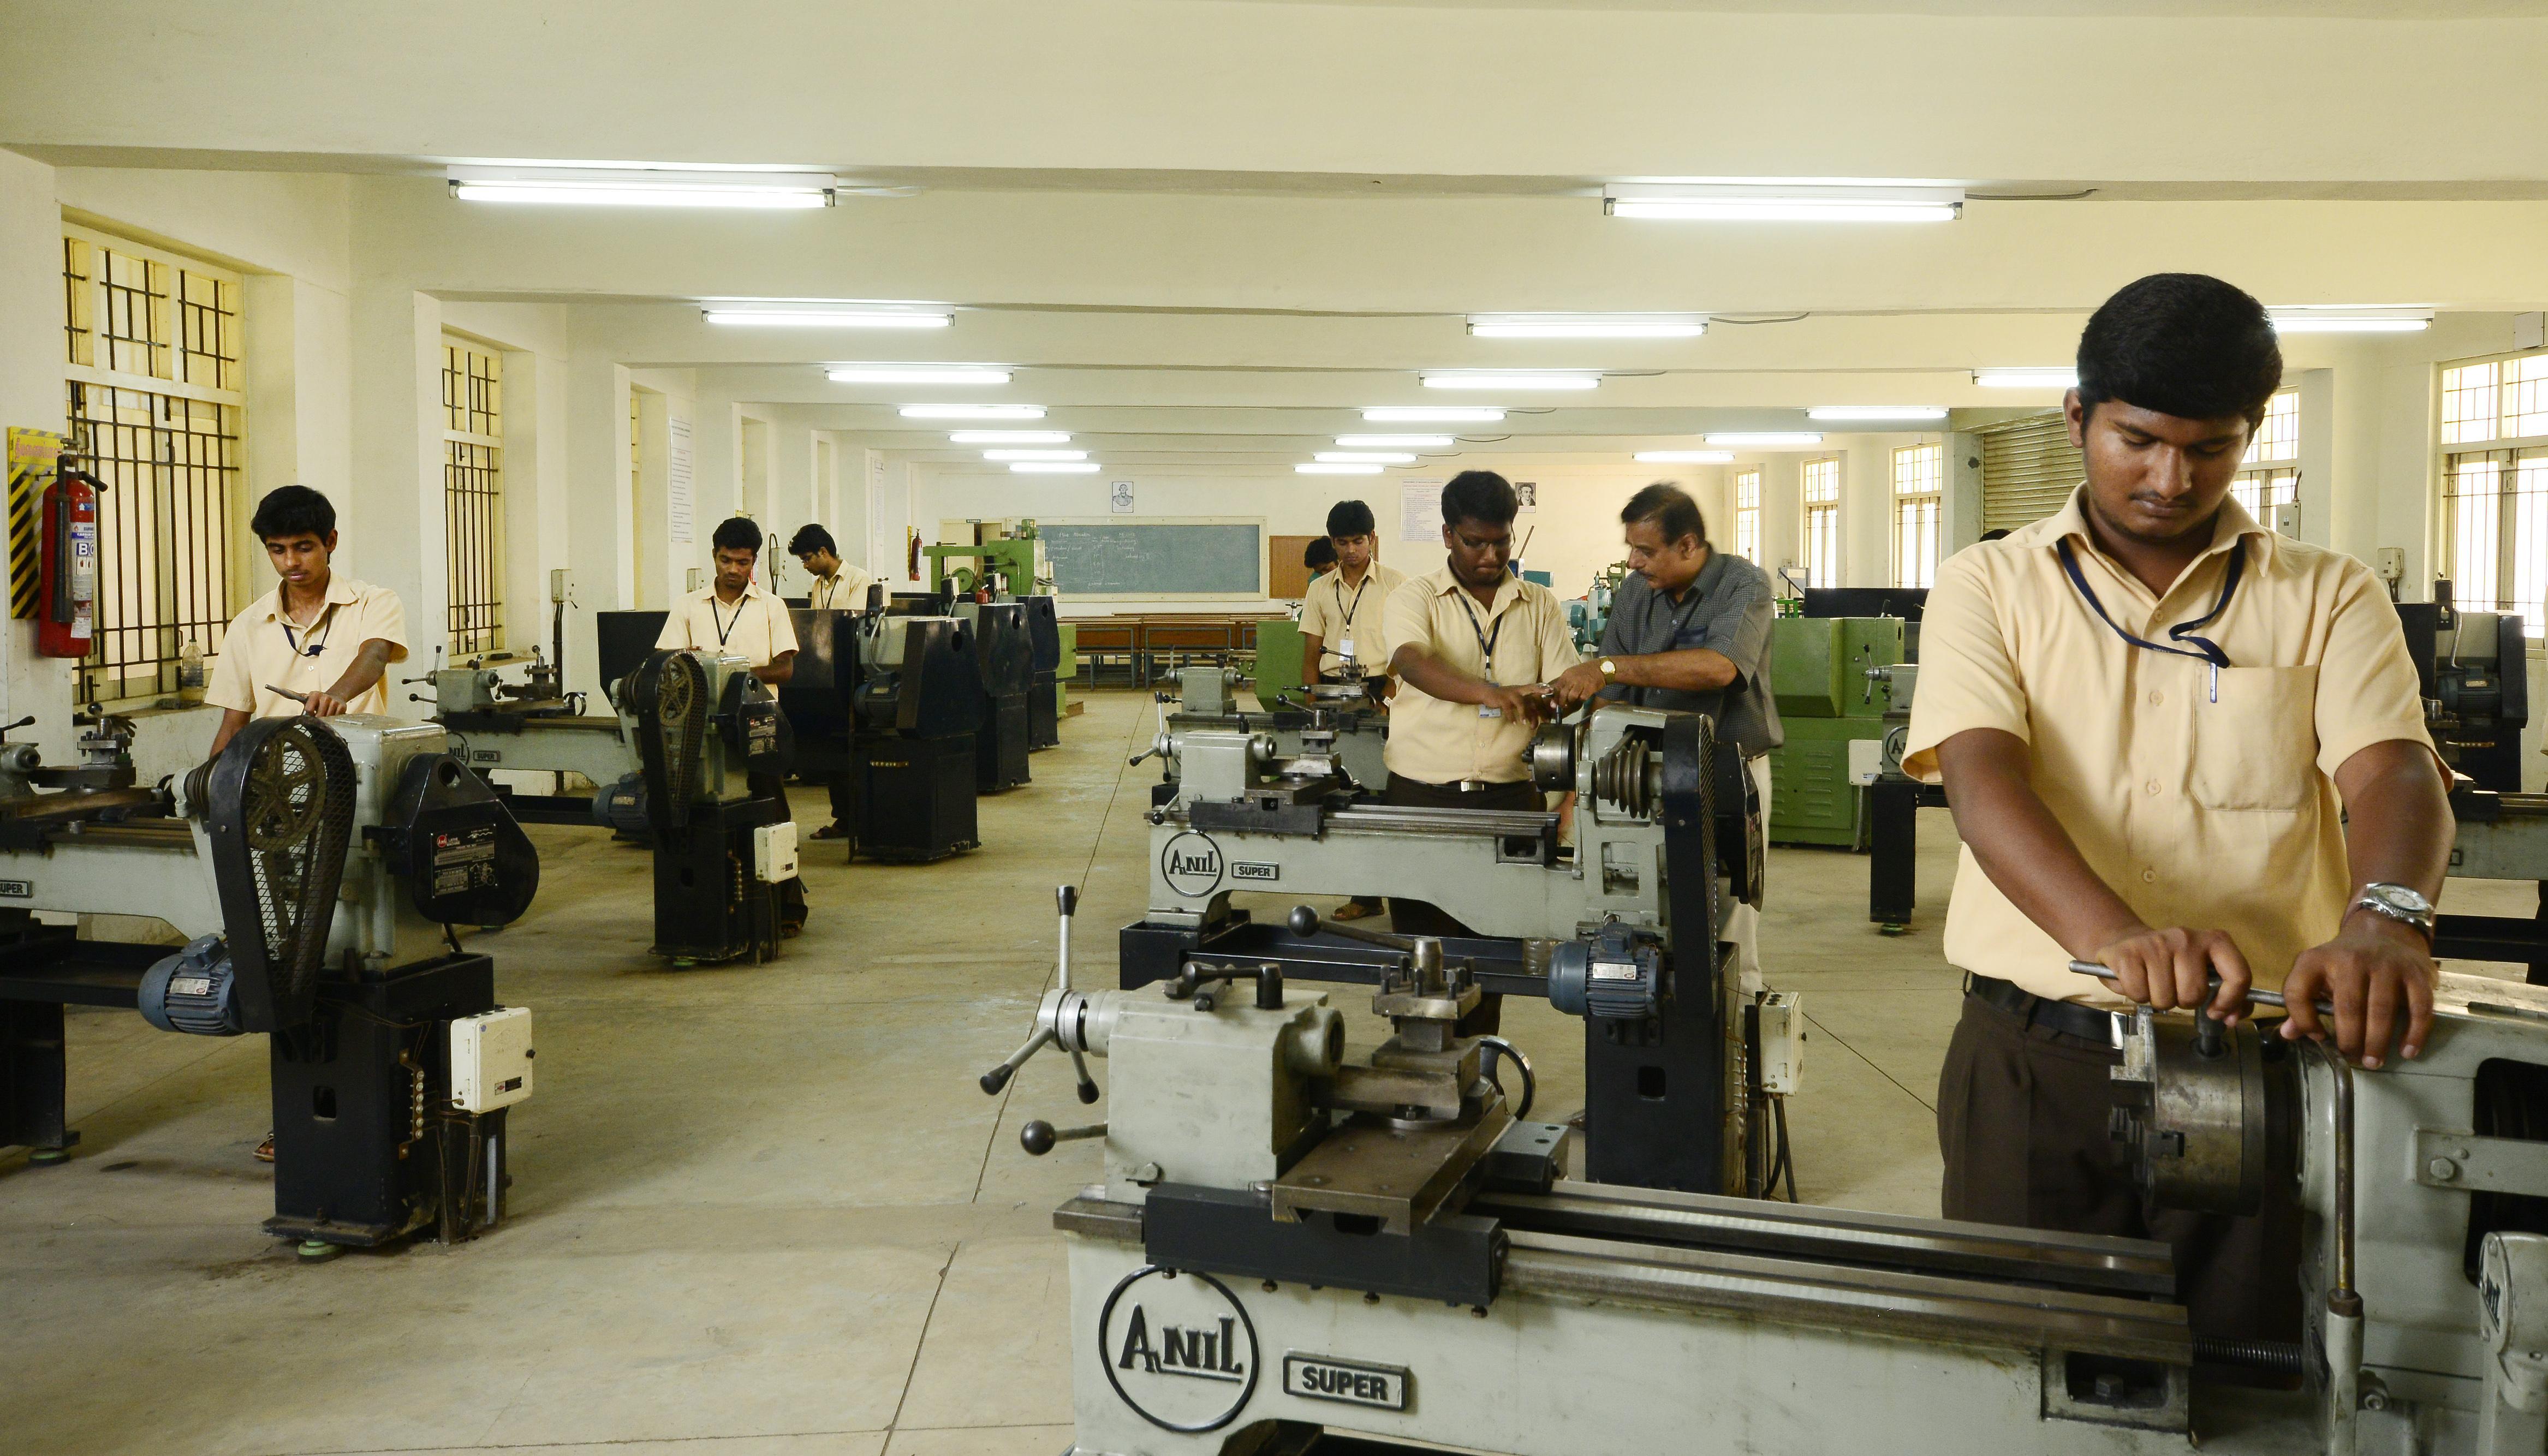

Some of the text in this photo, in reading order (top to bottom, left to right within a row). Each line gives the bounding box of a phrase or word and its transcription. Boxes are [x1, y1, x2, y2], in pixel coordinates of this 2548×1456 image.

[449, 744, 466, 757] NIL
[1239, 866, 1270, 877] SUPER
[0, 883, 23, 894] UPER
[1302, 1365, 1389, 1401] SUPER
